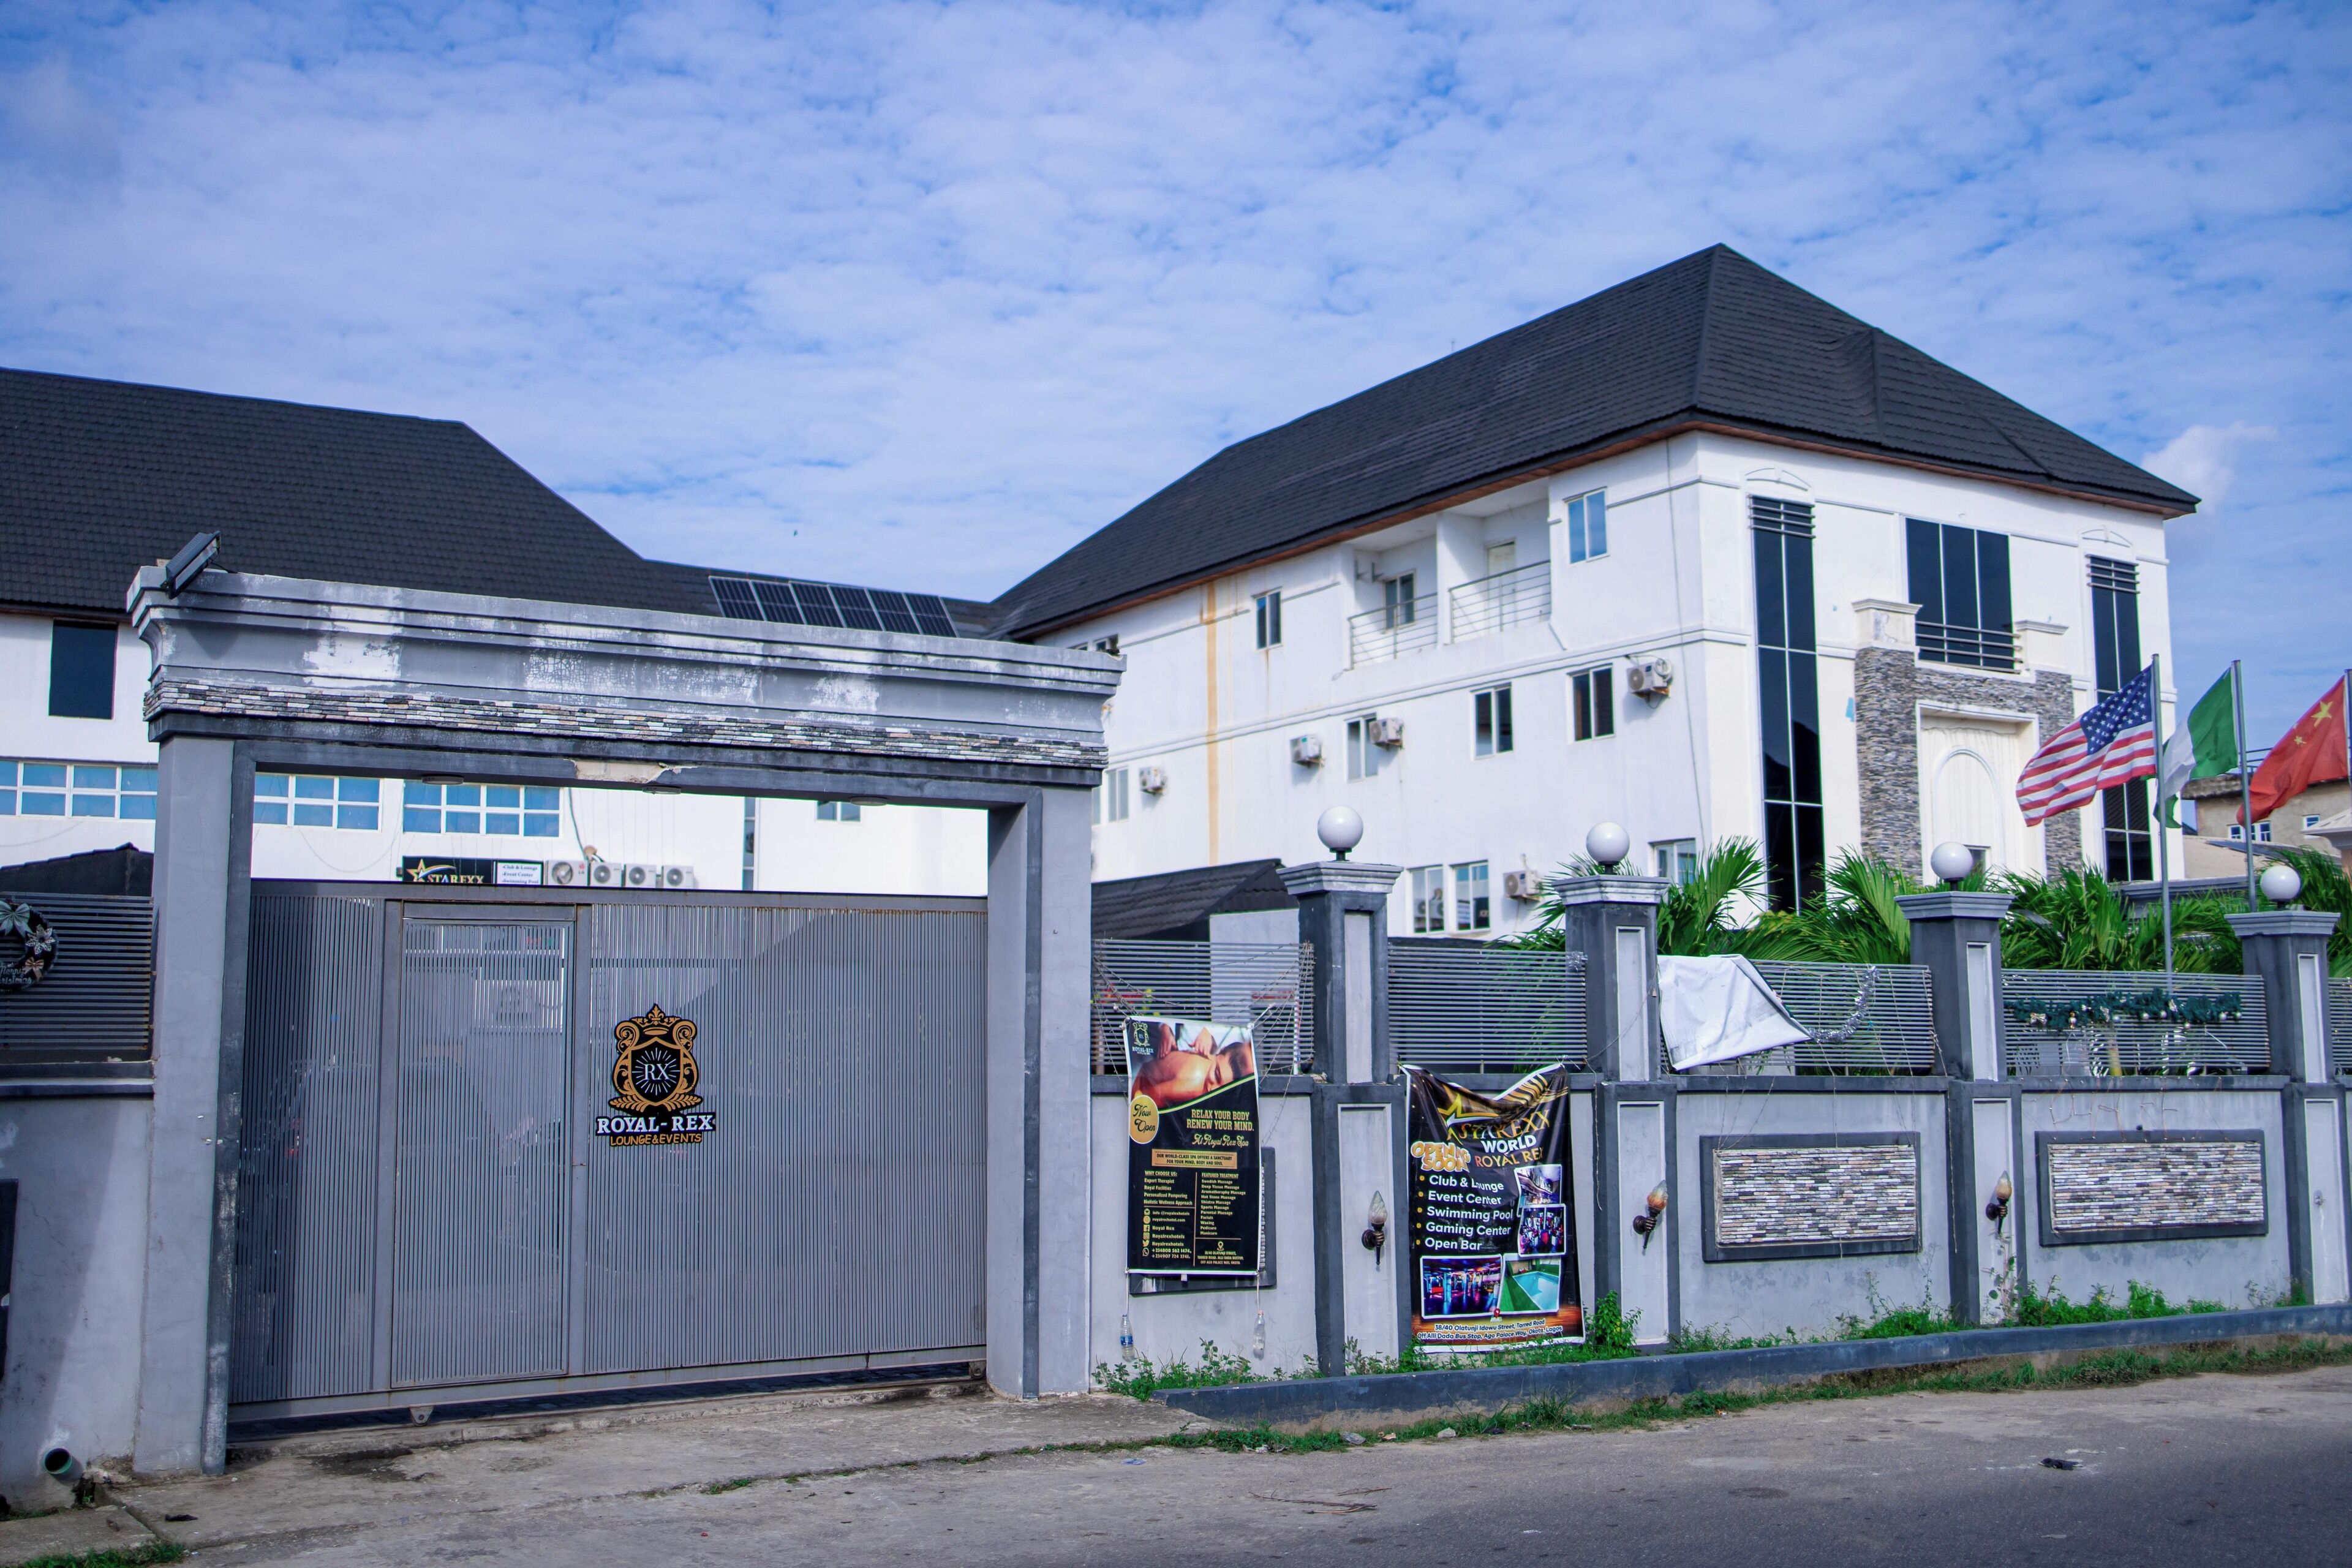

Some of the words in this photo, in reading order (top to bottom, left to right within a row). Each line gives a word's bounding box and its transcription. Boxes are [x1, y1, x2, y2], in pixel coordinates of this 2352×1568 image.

[644, 1063, 670, 1080] RX
[1133, 1104, 1152, 1117] Now
[1191, 1109, 1213, 1119] RELAX
[1214, 1110, 1231, 1120] YOUR
[1232, 1111, 1250, 1121] BODY
[597, 1117, 659, 1133] ROYAL
[671, 1115, 713, 1131] REX
[1134, 1118, 1156, 1133] Open
[1186, 1119, 1213, 1129] RENEW
[1214, 1120, 1232, 1130] YOUR
[1234, 1121, 1254, 1131] MIND.
[1458, 1110, 1550, 1139] STAREXX
[610, 1133, 702, 1146] LOUNGE&EVENTS
[1192, 1134, 1203, 1145] At
[1203, 1134, 1223, 1148] Royal
[1223, 1135, 1237, 1146] Rex
[1237, 1135, 1250, 1147] Spa
[1480, 1134, 1537, 1154] WORLD
[1411, 1140, 1471, 1163] OPENING
[1474, 1153, 1520, 1167] ROYAL
[1521, 1147, 1544, 1162] REX
[1421, 1156, 1470, 1173] SOON
[1429, 1175, 1457, 1187] Club
[1460, 1177, 1468, 1187] &
[1471, 1178, 1504, 1193] Lounge
[1428, 1190, 1463, 1203] Event
[1466, 1193, 1502, 1205] Center
[1427, 1206, 1490, 1222] Swimming
[1493, 1209, 1513, 1221] Pool
[1425, 1221, 1474, 1237] Gaming
[1476, 1225, 1511, 1236] Center
[1425, 1237, 1458, 1251] Open
[1461, 1239, 1482, 1251] Bar
[1546, 1325, 1562, 1334] Lagos
